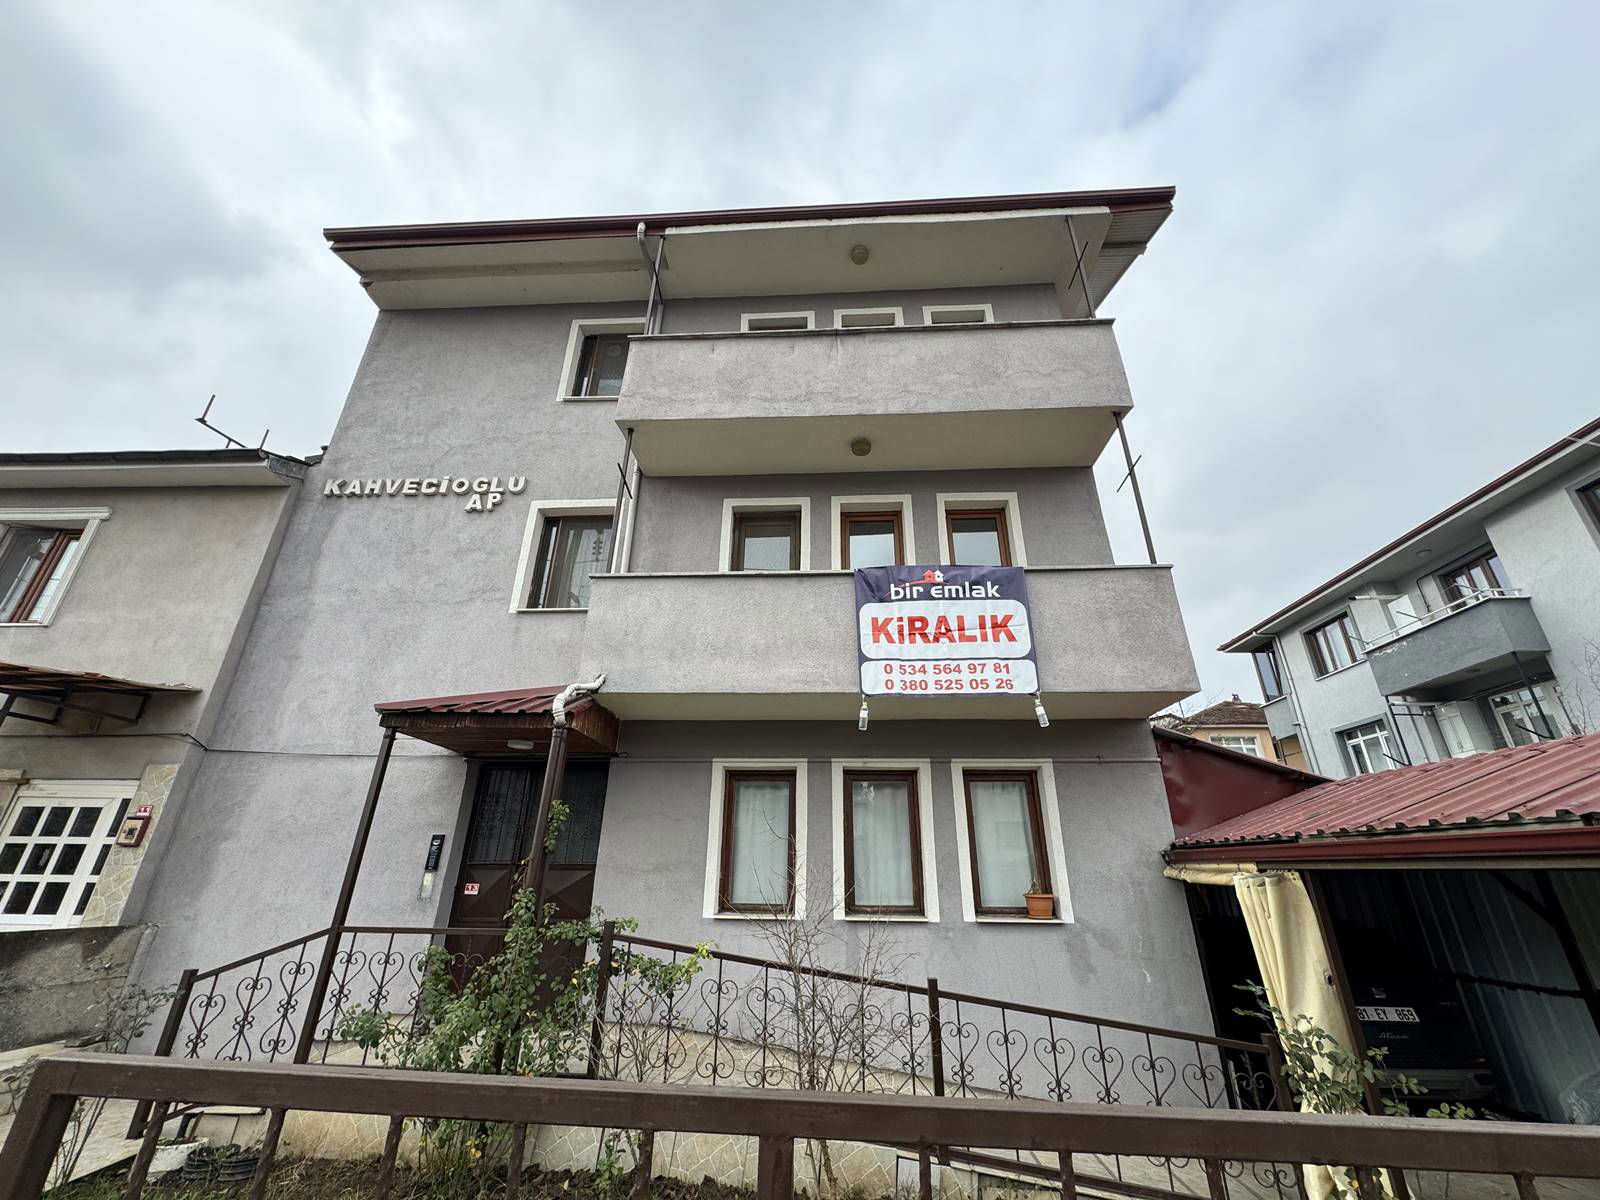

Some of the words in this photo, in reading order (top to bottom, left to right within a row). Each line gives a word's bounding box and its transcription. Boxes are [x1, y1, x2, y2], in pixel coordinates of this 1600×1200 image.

[464, 493, 503, 512] AP
[890, 583, 923, 600] bir
[930, 581, 1001, 599] emlak
[884, 663, 894, 675] 0
[899, 664, 927, 675] 534
[933, 663, 962, 675] 564
[967, 663, 987, 674] 97
[993, 663, 1011, 674] 81
[884, 679, 895, 690] 0
[900, 679, 928, 691] 380
[934, 679, 964, 690] 525
[969, 679, 990, 690] 05
[995, 678, 1014, 690] 26
[1374, 1008, 1388, 1020] EY
